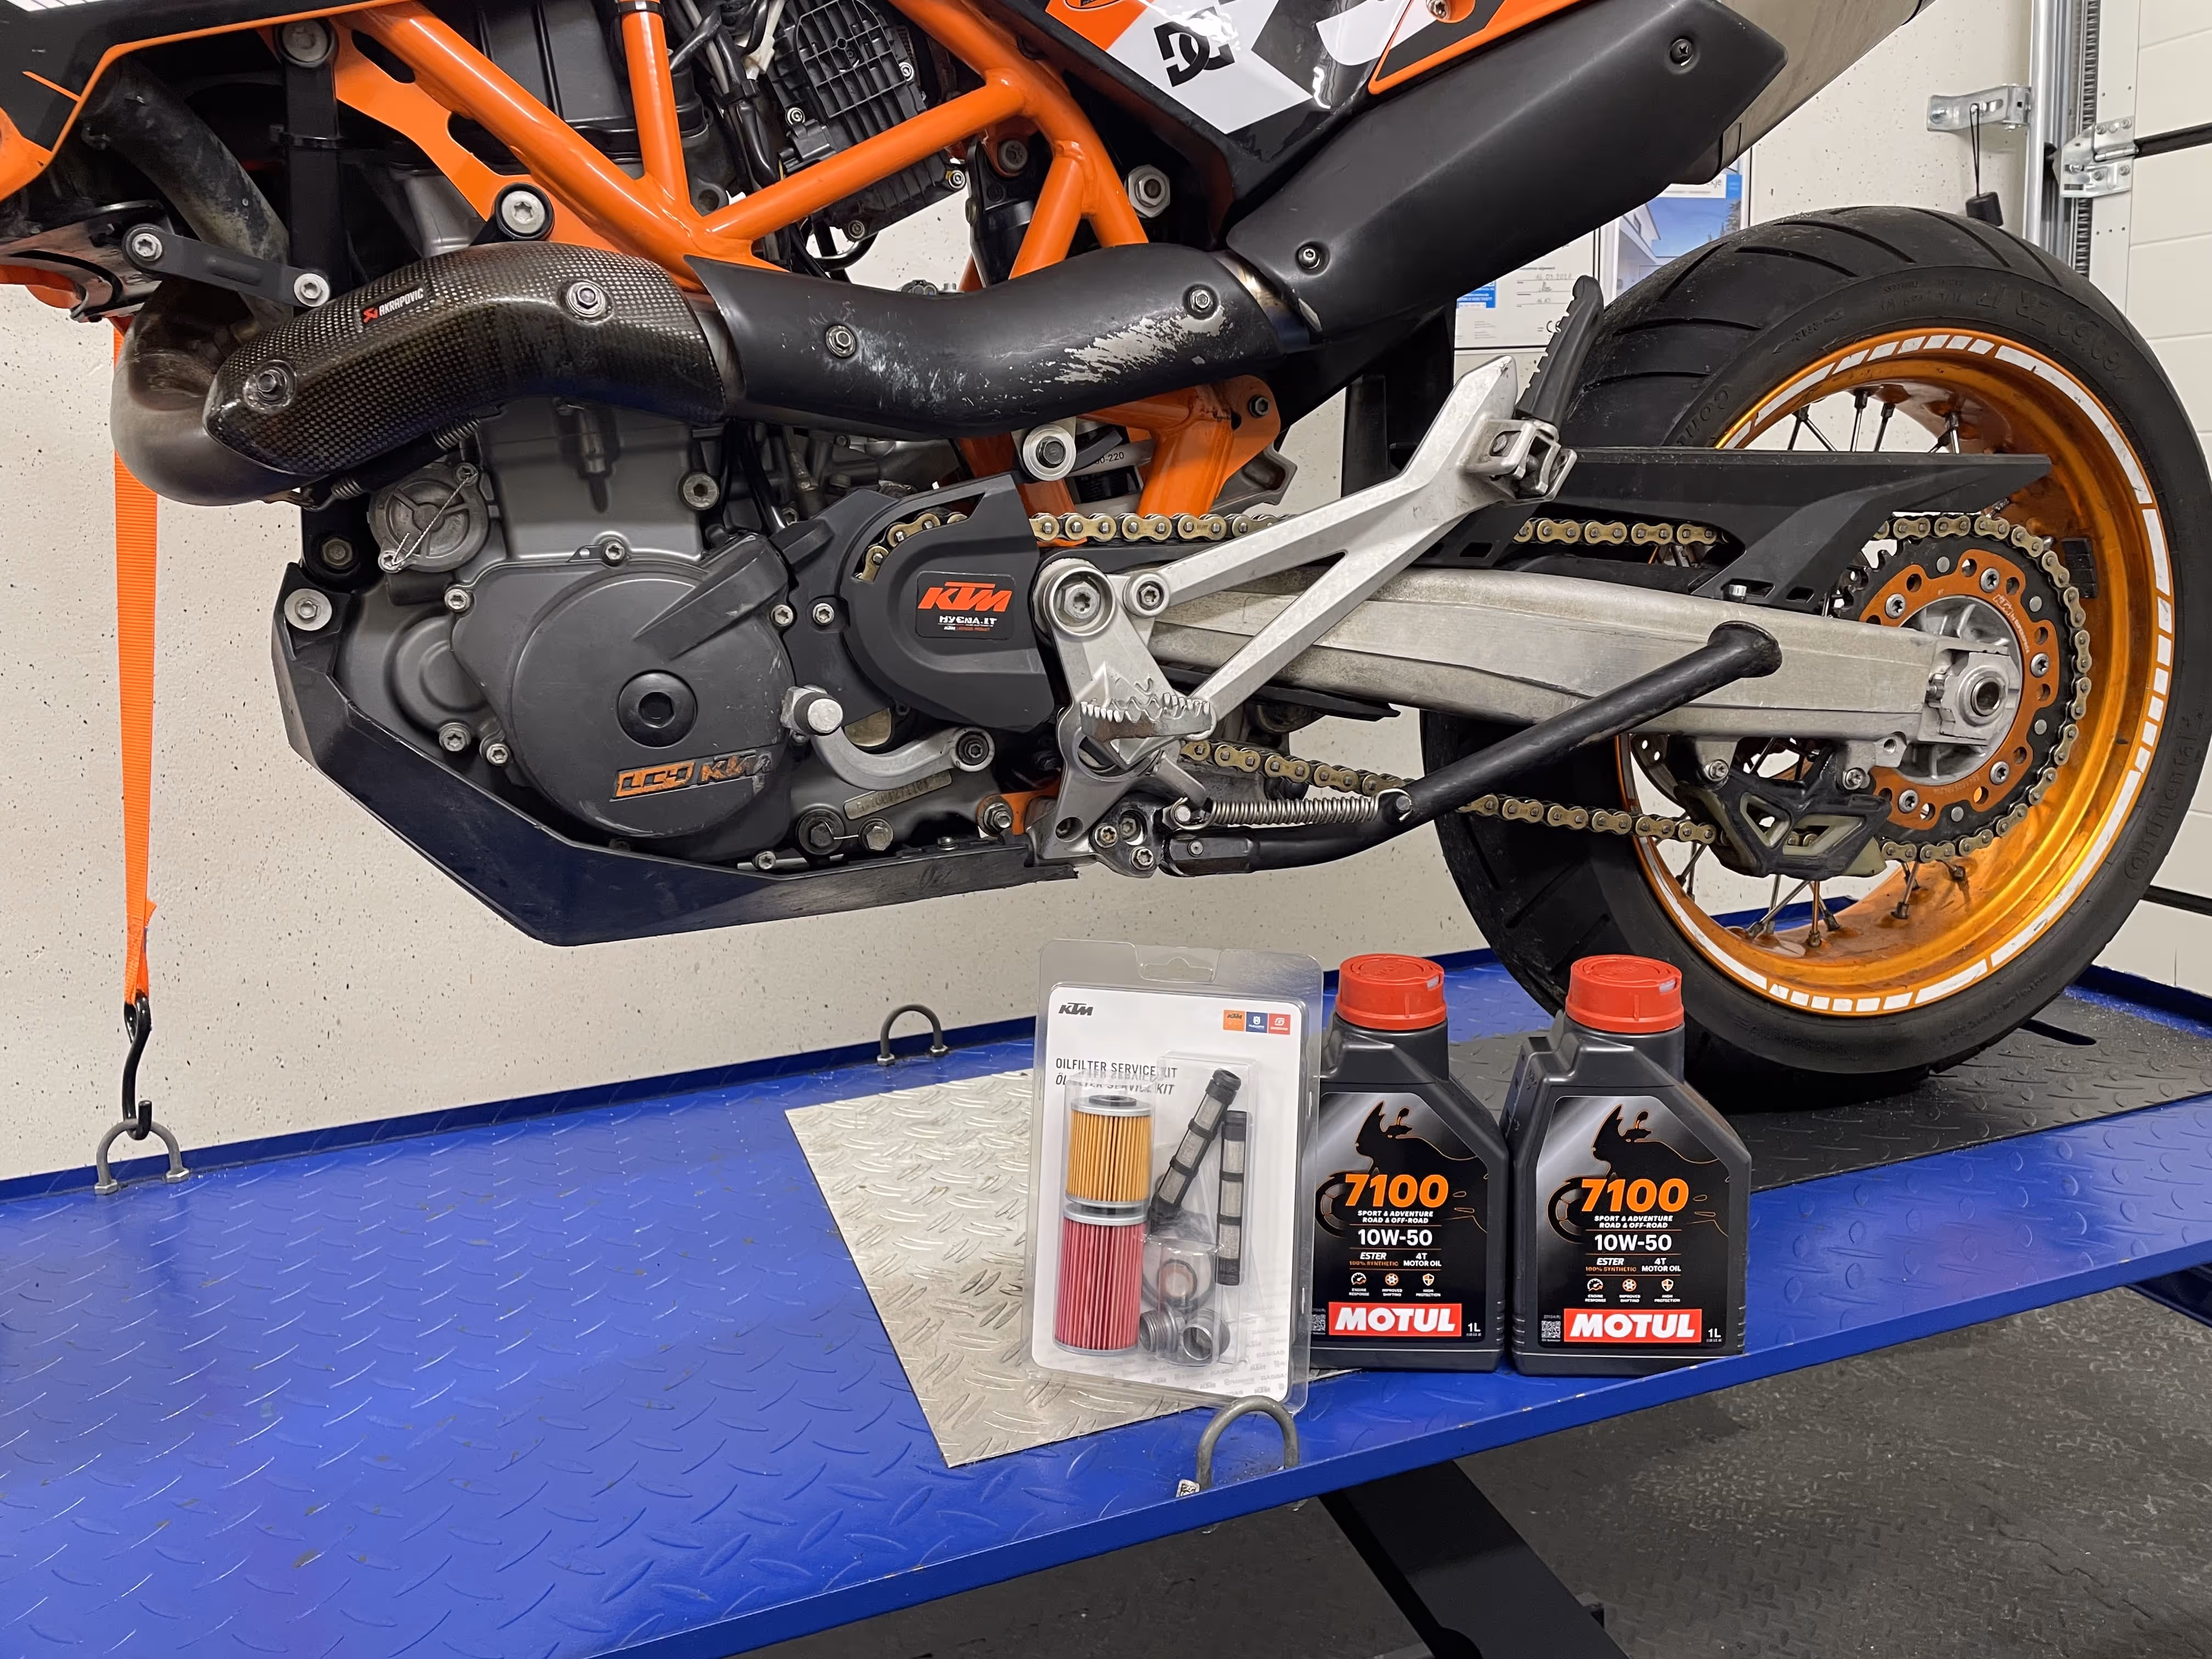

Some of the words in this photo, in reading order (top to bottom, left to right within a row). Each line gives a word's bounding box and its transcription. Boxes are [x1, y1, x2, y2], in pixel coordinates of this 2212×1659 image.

[379, 287, 424, 316] AKRAPOVIC
[918, 582, 1012, 612] KTM
[939, 616, 997, 624] HYENA.IT
[1058, 1002, 1093, 1015] KTM
[1056, 1058, 1107, 1071] OILFILTER
[1111, 1063, 1156, 1076] SERVICE
[1157, 1084, 1175, 1094] KIT
[1345, 1174, 1448, 1207] 7100
[1581, 1178, 1689, 1212] 7100
[1358, 1229, 1433, 1246] 10W-50
[1594, 1234, 1672, 1251] 10W-50
[1360, 1252, 1387, 1260] ESTER
[1596, 1257, 1624, 1266] ESTER
[1335, 1307, 1455, 1332] MOTUL
[1468, 1323, 1481, 1332] 1L
[1569, 1313, 1695, 1338] MOTUL
[1708, 1328, 1722, 1338] 1L
